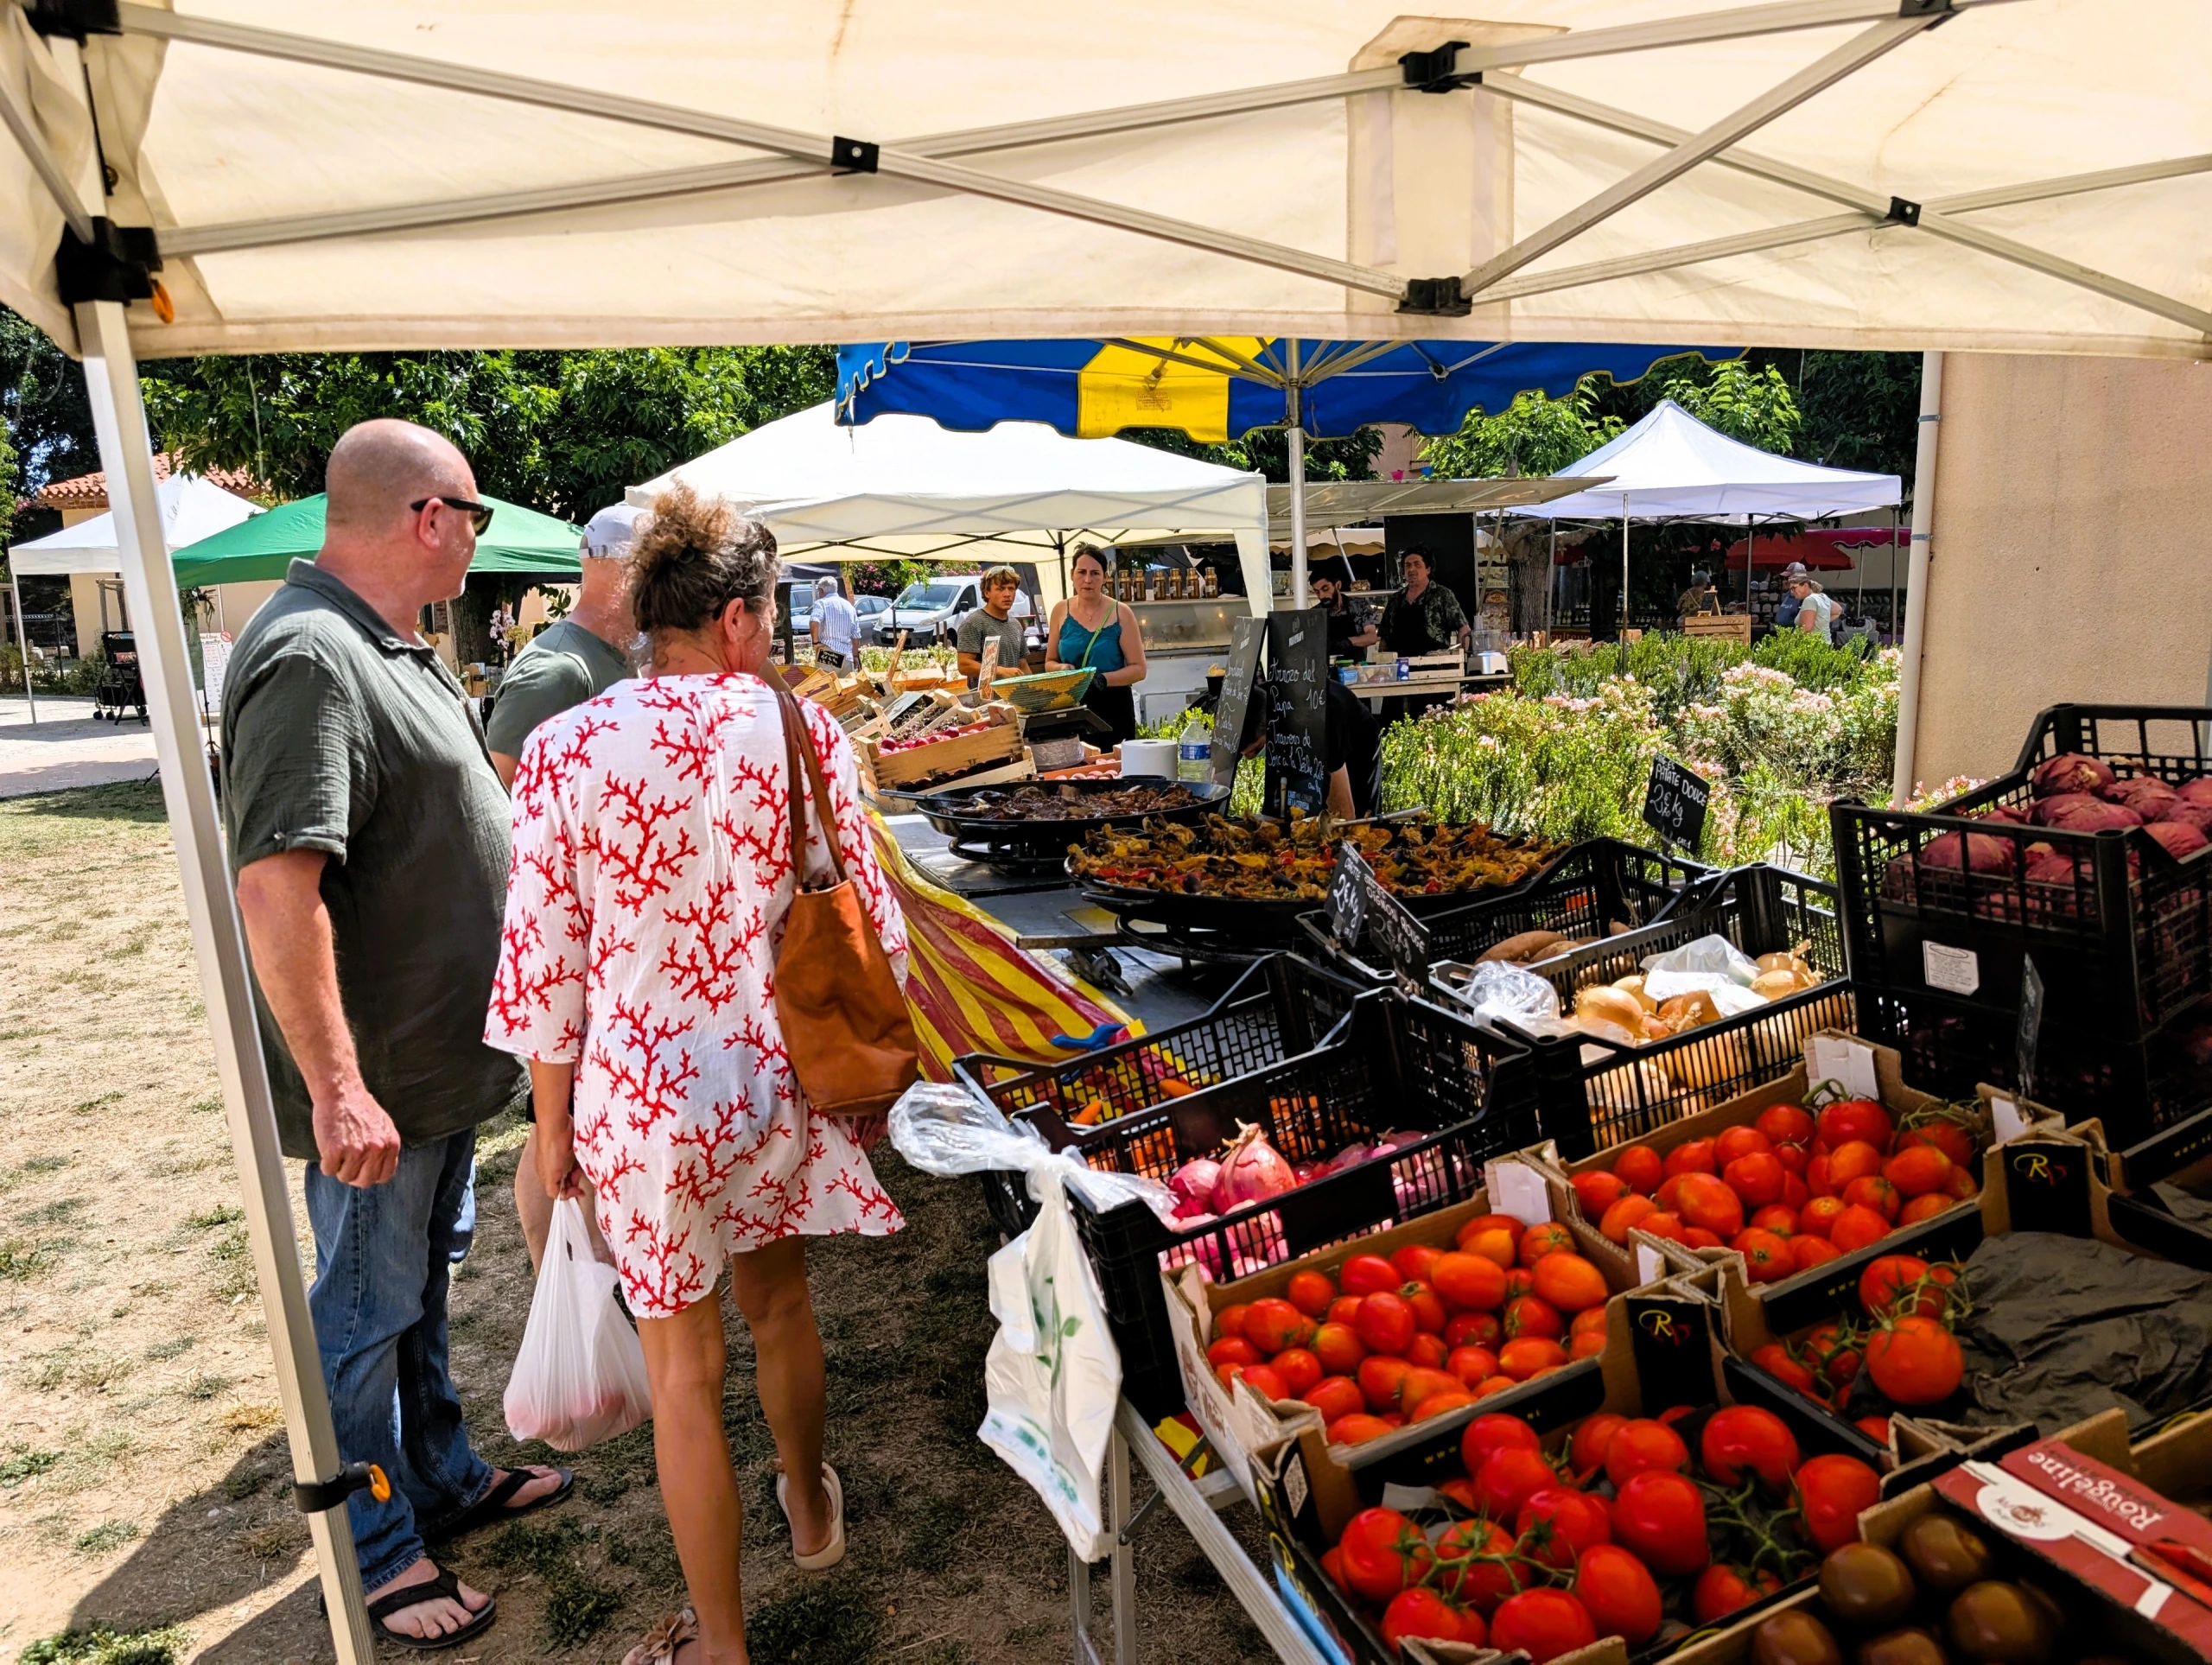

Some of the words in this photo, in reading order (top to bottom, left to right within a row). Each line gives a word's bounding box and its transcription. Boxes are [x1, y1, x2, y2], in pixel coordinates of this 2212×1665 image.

[1270, 685, 1294, 718] Papa
[1306, 688, 1325, 710] 10€
[1303, 728, 1313, 748] de
[1655, 763, 1681, 786] PATATE
[1681, 778, 1707, 807] DOUCE
[1400, 916, 1426, 955] ROUGE
[2027, 1452, 2164, 1531] Rougeline
